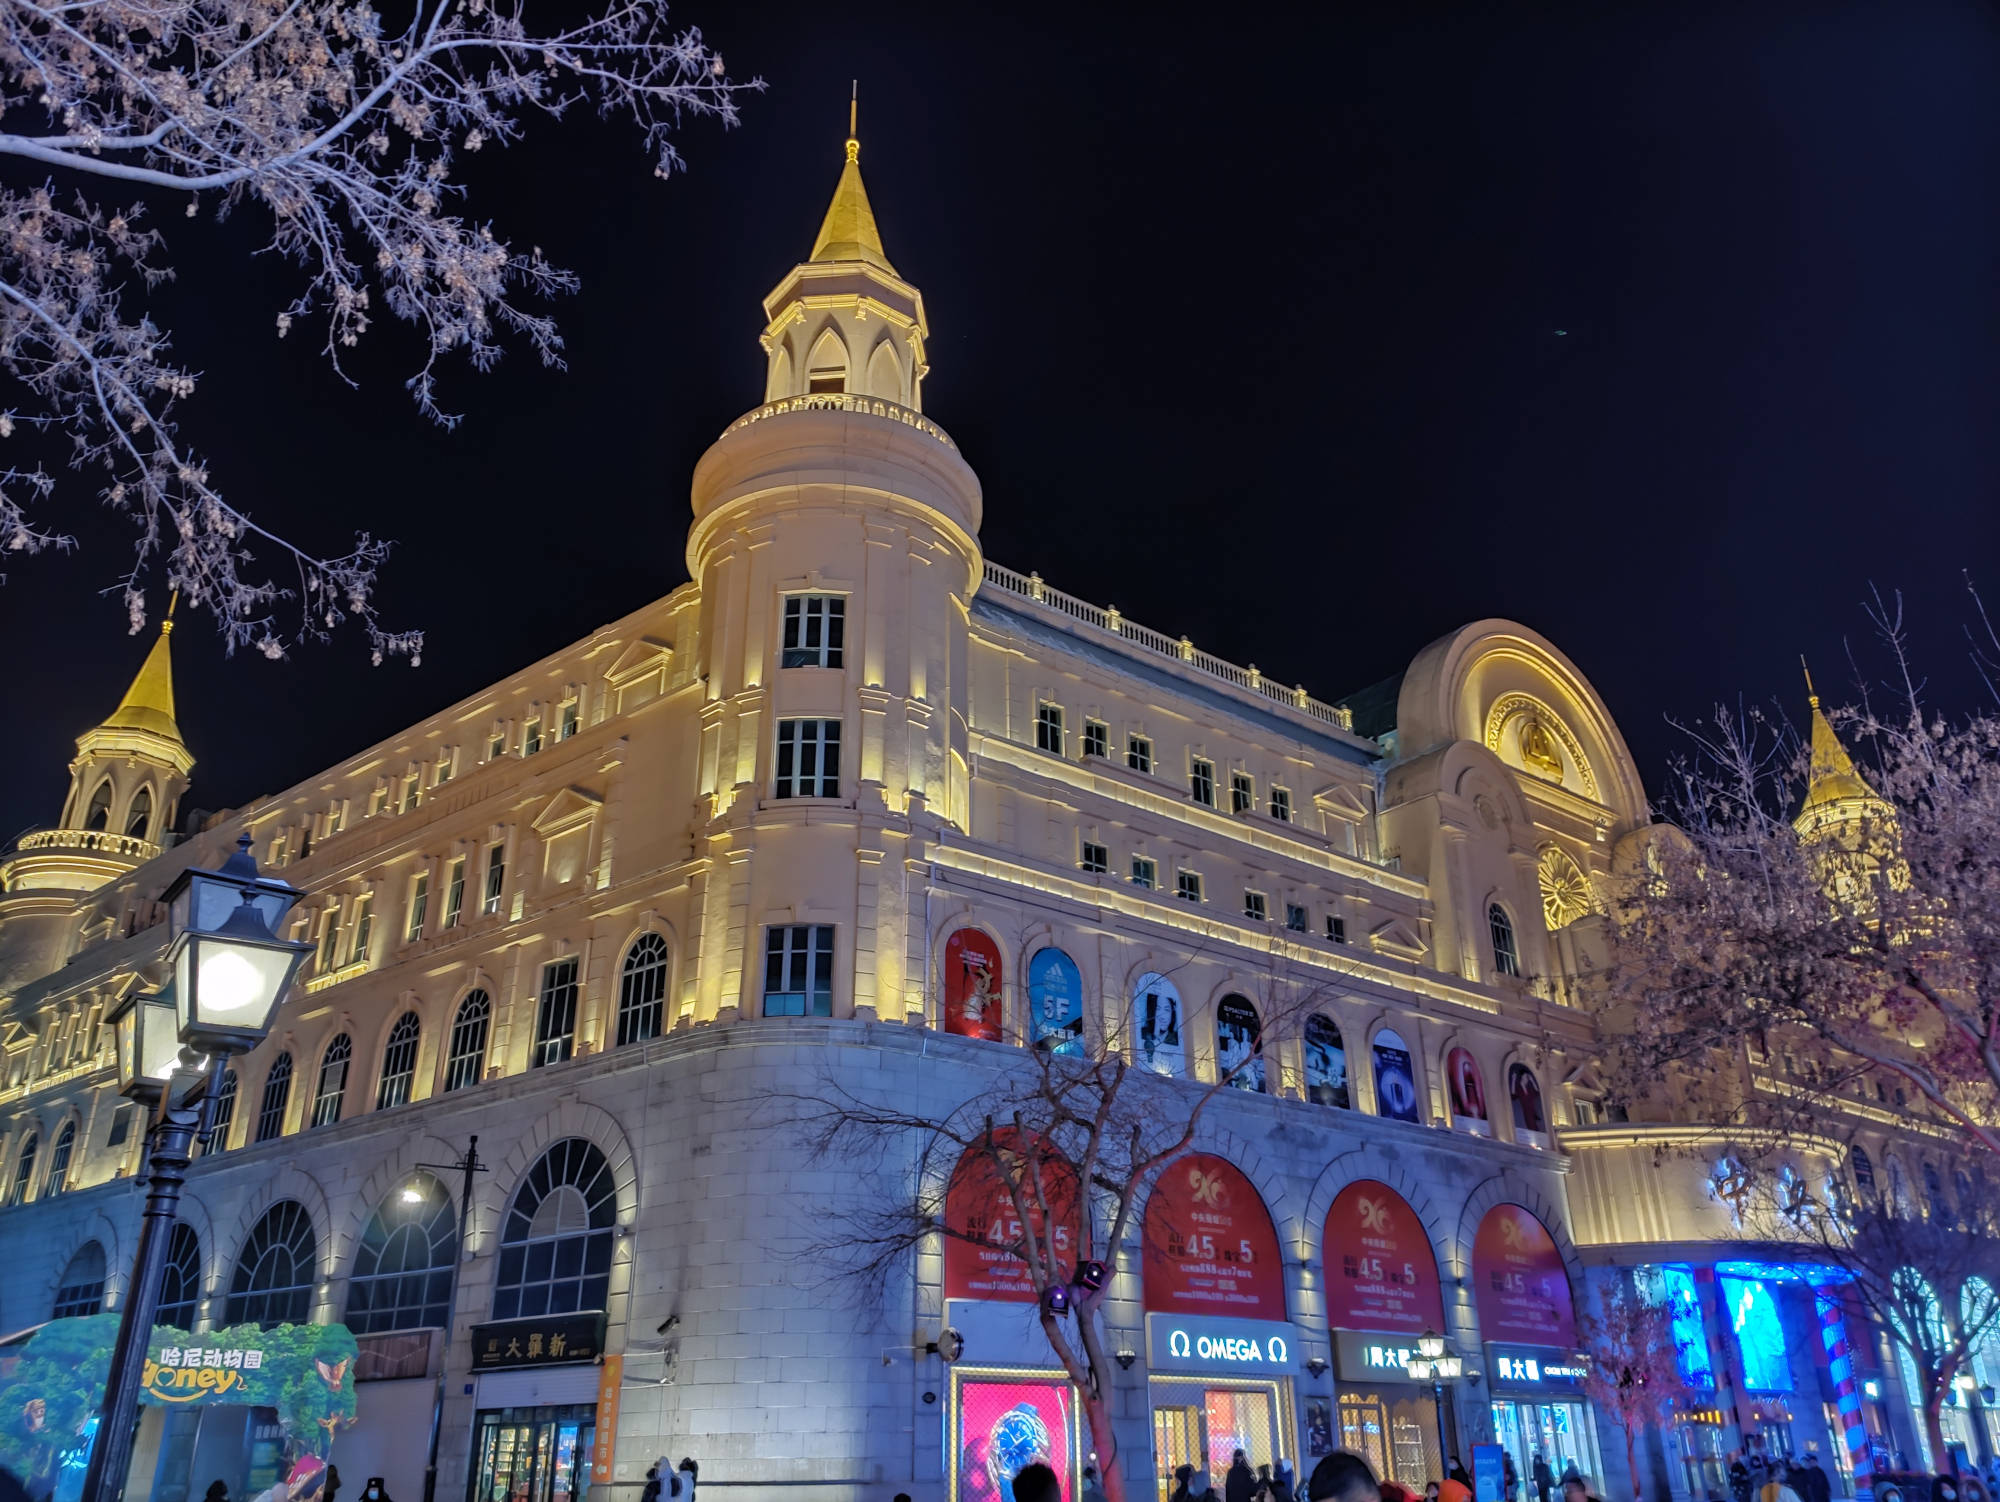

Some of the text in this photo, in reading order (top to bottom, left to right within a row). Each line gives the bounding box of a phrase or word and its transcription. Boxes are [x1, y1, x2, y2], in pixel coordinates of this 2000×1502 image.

[1043, 994, 1071, 1022] 5F
[160, 1347, 263, 1369] 哈尼动物园
[1197, 1336, 1263, 1361] OMEGA
